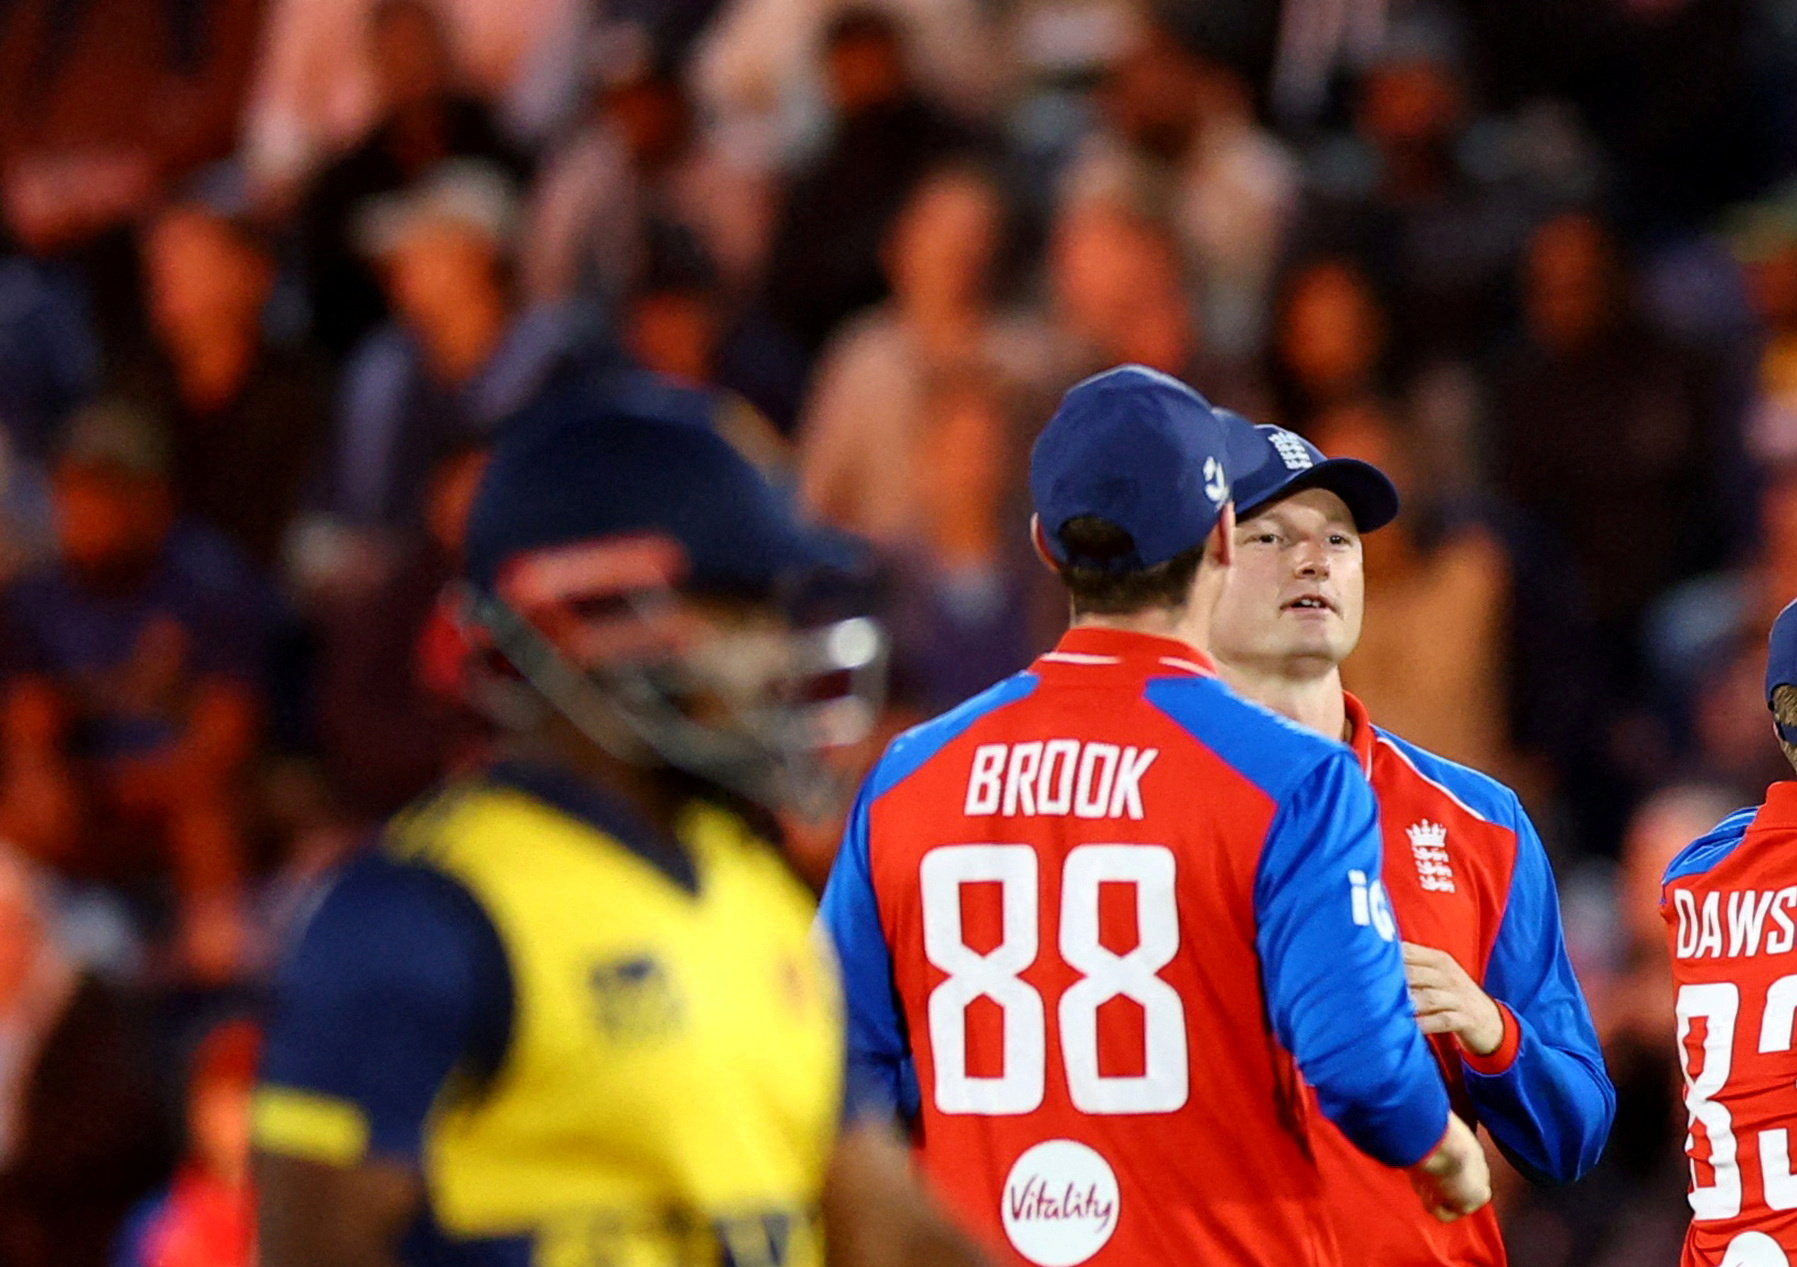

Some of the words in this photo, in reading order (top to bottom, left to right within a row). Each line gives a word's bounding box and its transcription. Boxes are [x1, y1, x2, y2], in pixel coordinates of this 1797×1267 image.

[964, 739, 1158, 820] BROOK
[920, 843, 1189, 1115] 88
[1011, 1173, 1113, 1234] Vitality
